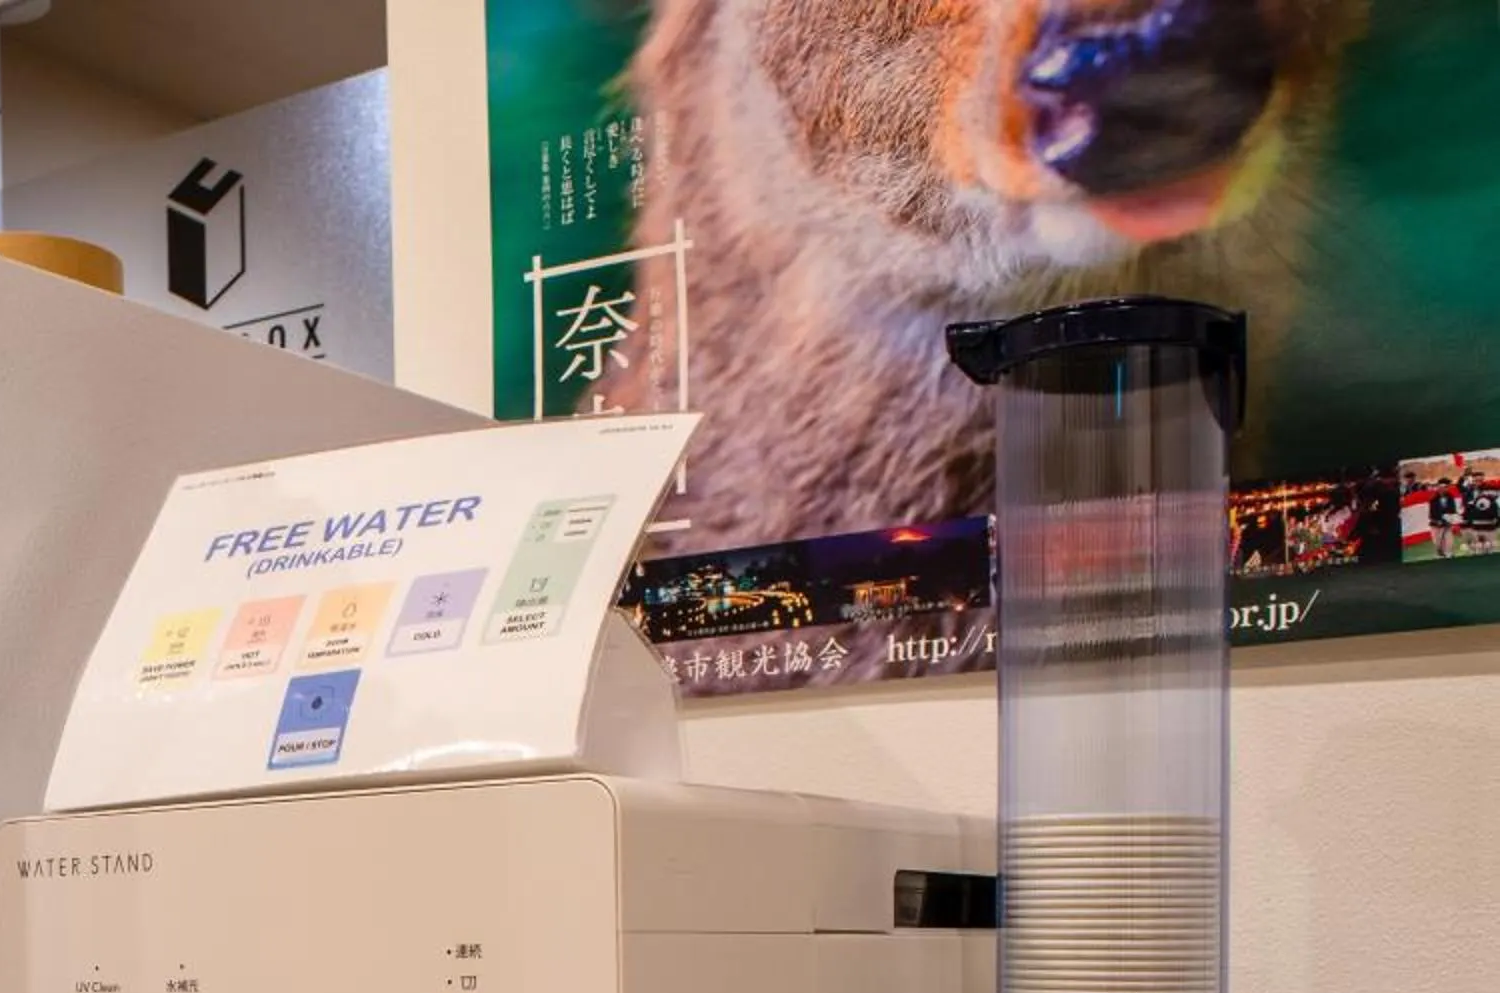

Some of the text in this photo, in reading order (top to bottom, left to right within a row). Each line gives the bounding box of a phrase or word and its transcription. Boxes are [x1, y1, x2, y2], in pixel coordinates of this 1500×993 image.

[205, 496, 482, 563] FREE WATER
[246, 538, 404, 579] (DRINKABLE)
[506, 611, 548, 624] SELECT
[413, 629, 441, 641] COLD
[500, 621, 547, 635] AMOUNT
[278, 741, 304, 753] POUR
[311, 738, 337, 750] STOP
[17, 853, 153, 878] WATER STAND
[456, 943, 482, 959] 連続
[75, 981, 120, 993] UV Clean
